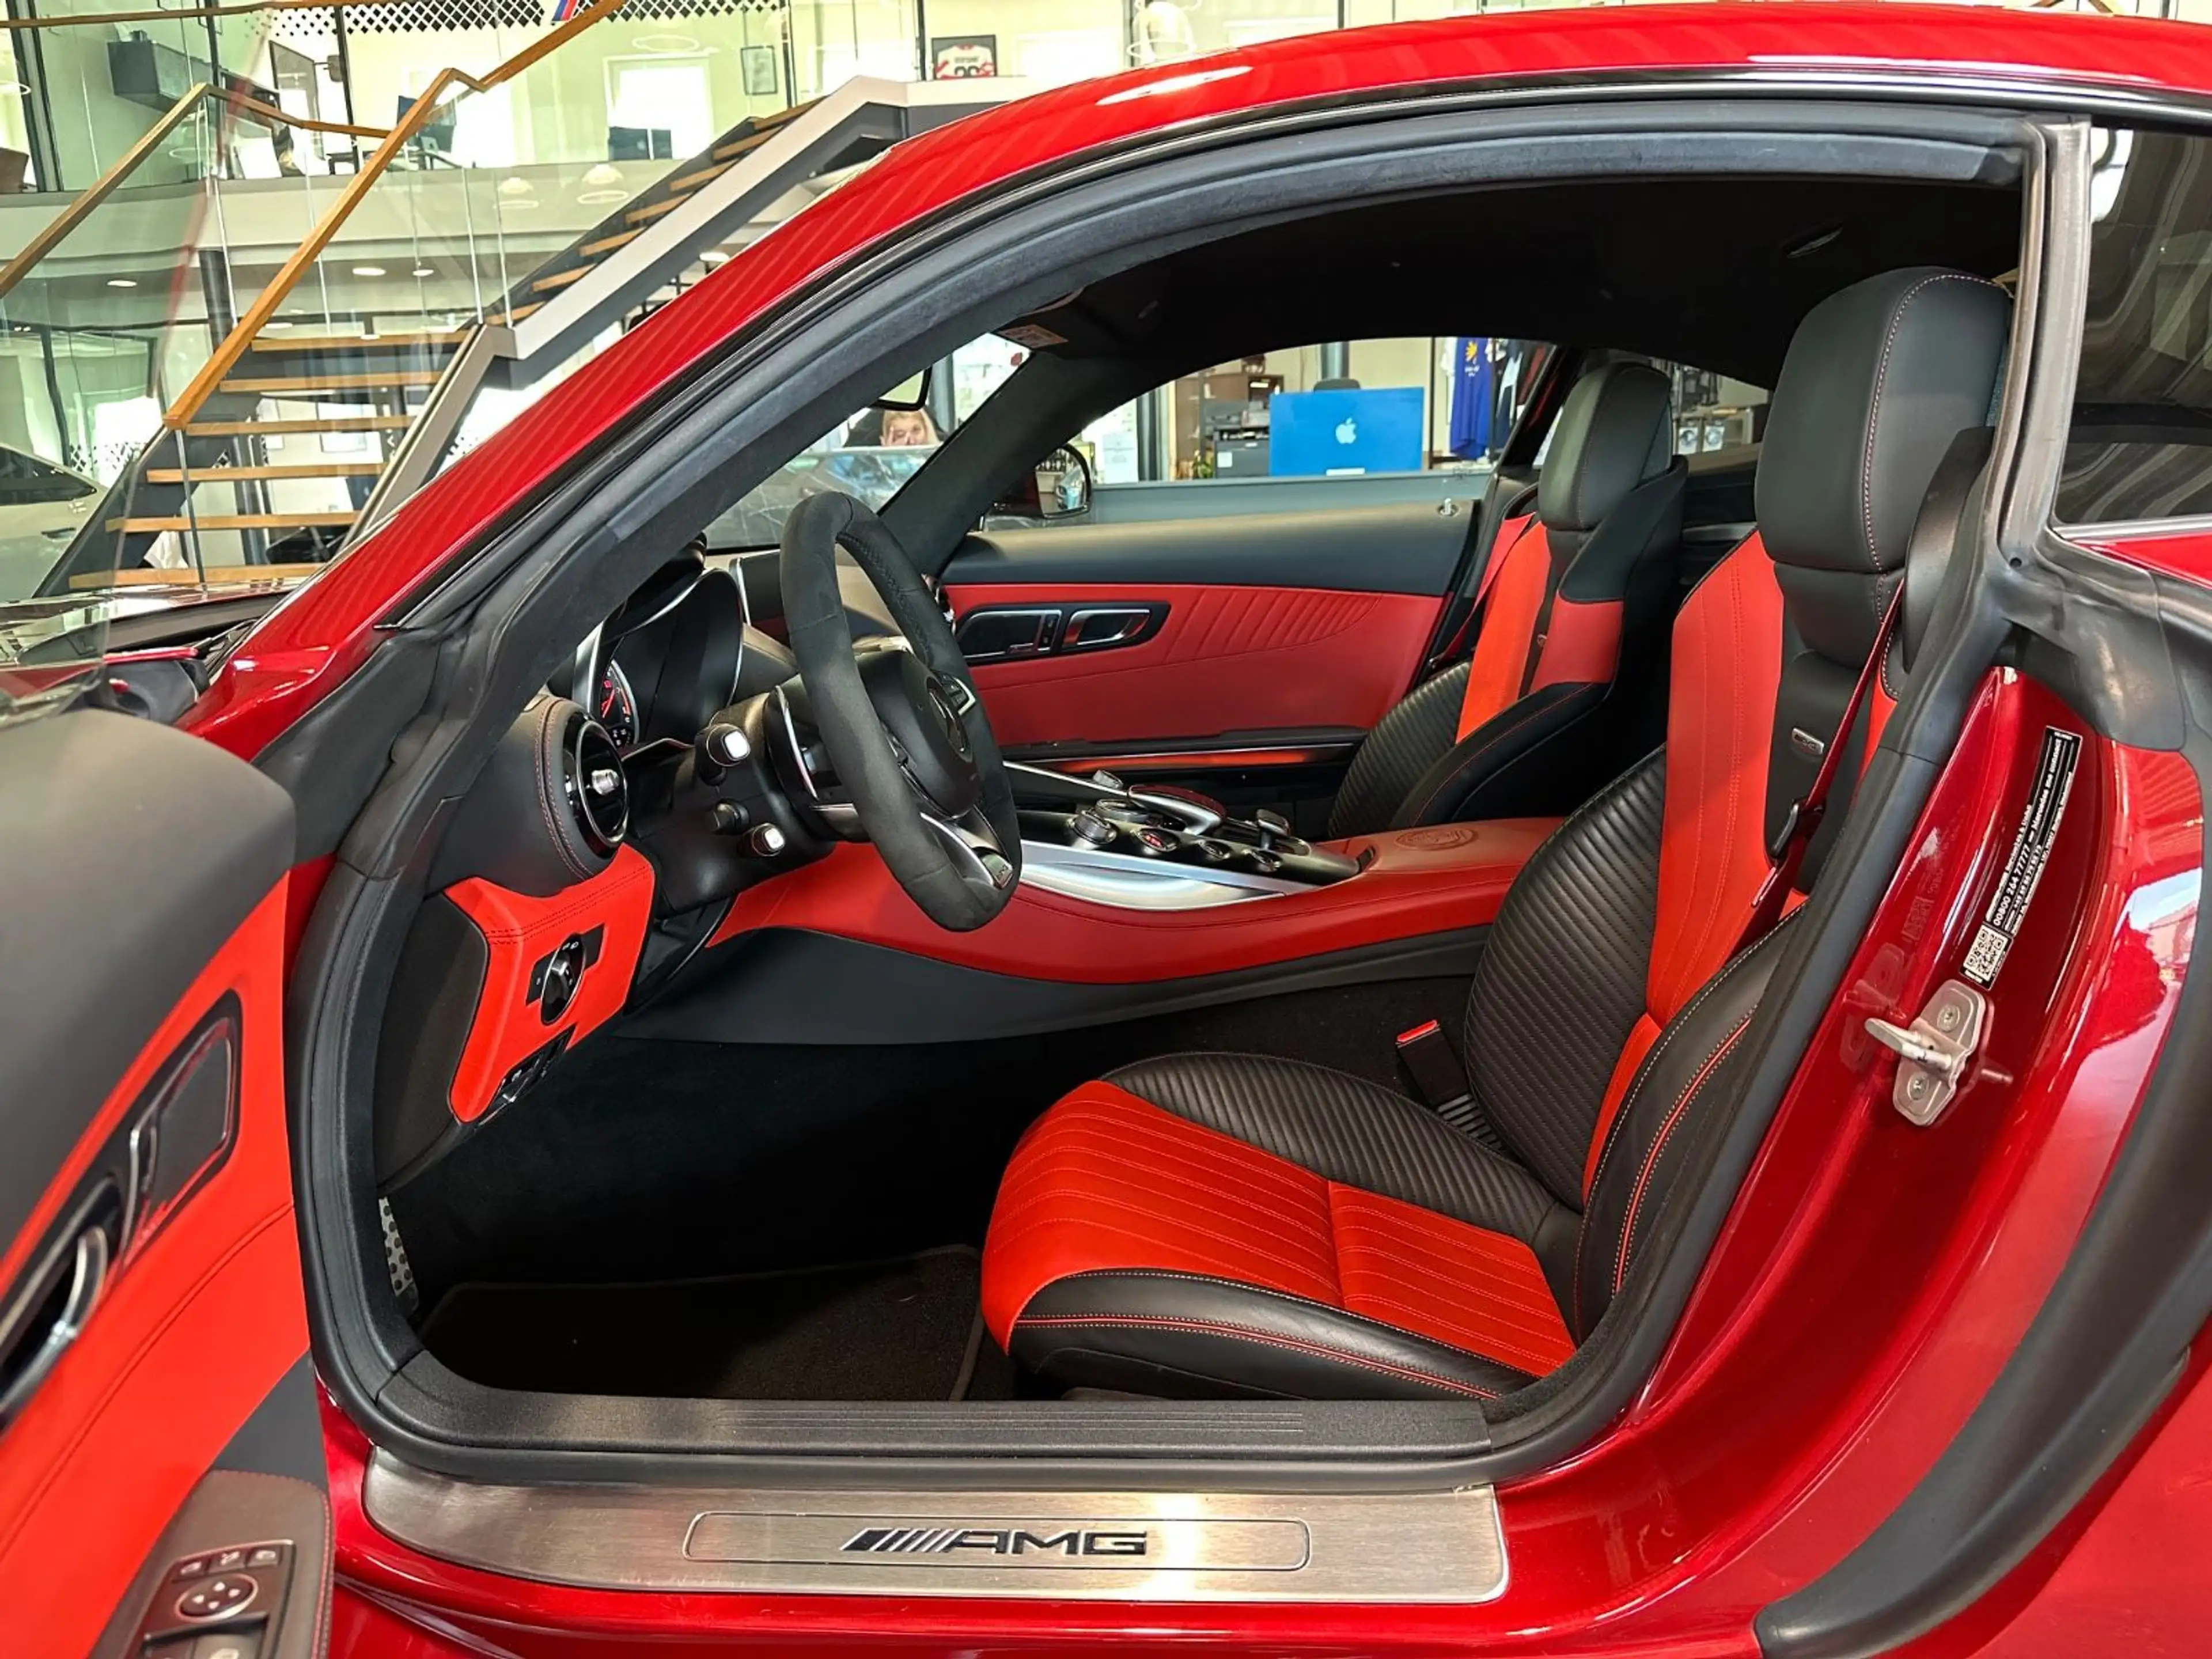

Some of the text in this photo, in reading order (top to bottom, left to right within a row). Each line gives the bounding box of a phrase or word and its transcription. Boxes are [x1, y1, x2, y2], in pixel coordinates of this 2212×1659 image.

[1994, 895, 2011, 926] 00800
[2006, 876, 2019, 895] 264
[2014, 844, 2031, 876] 77777
[2031, 789, 2049, 830] Mercedes
[2049, 738, 2062, 773] connect
[942, 1528, 1147, 1555] AMG
